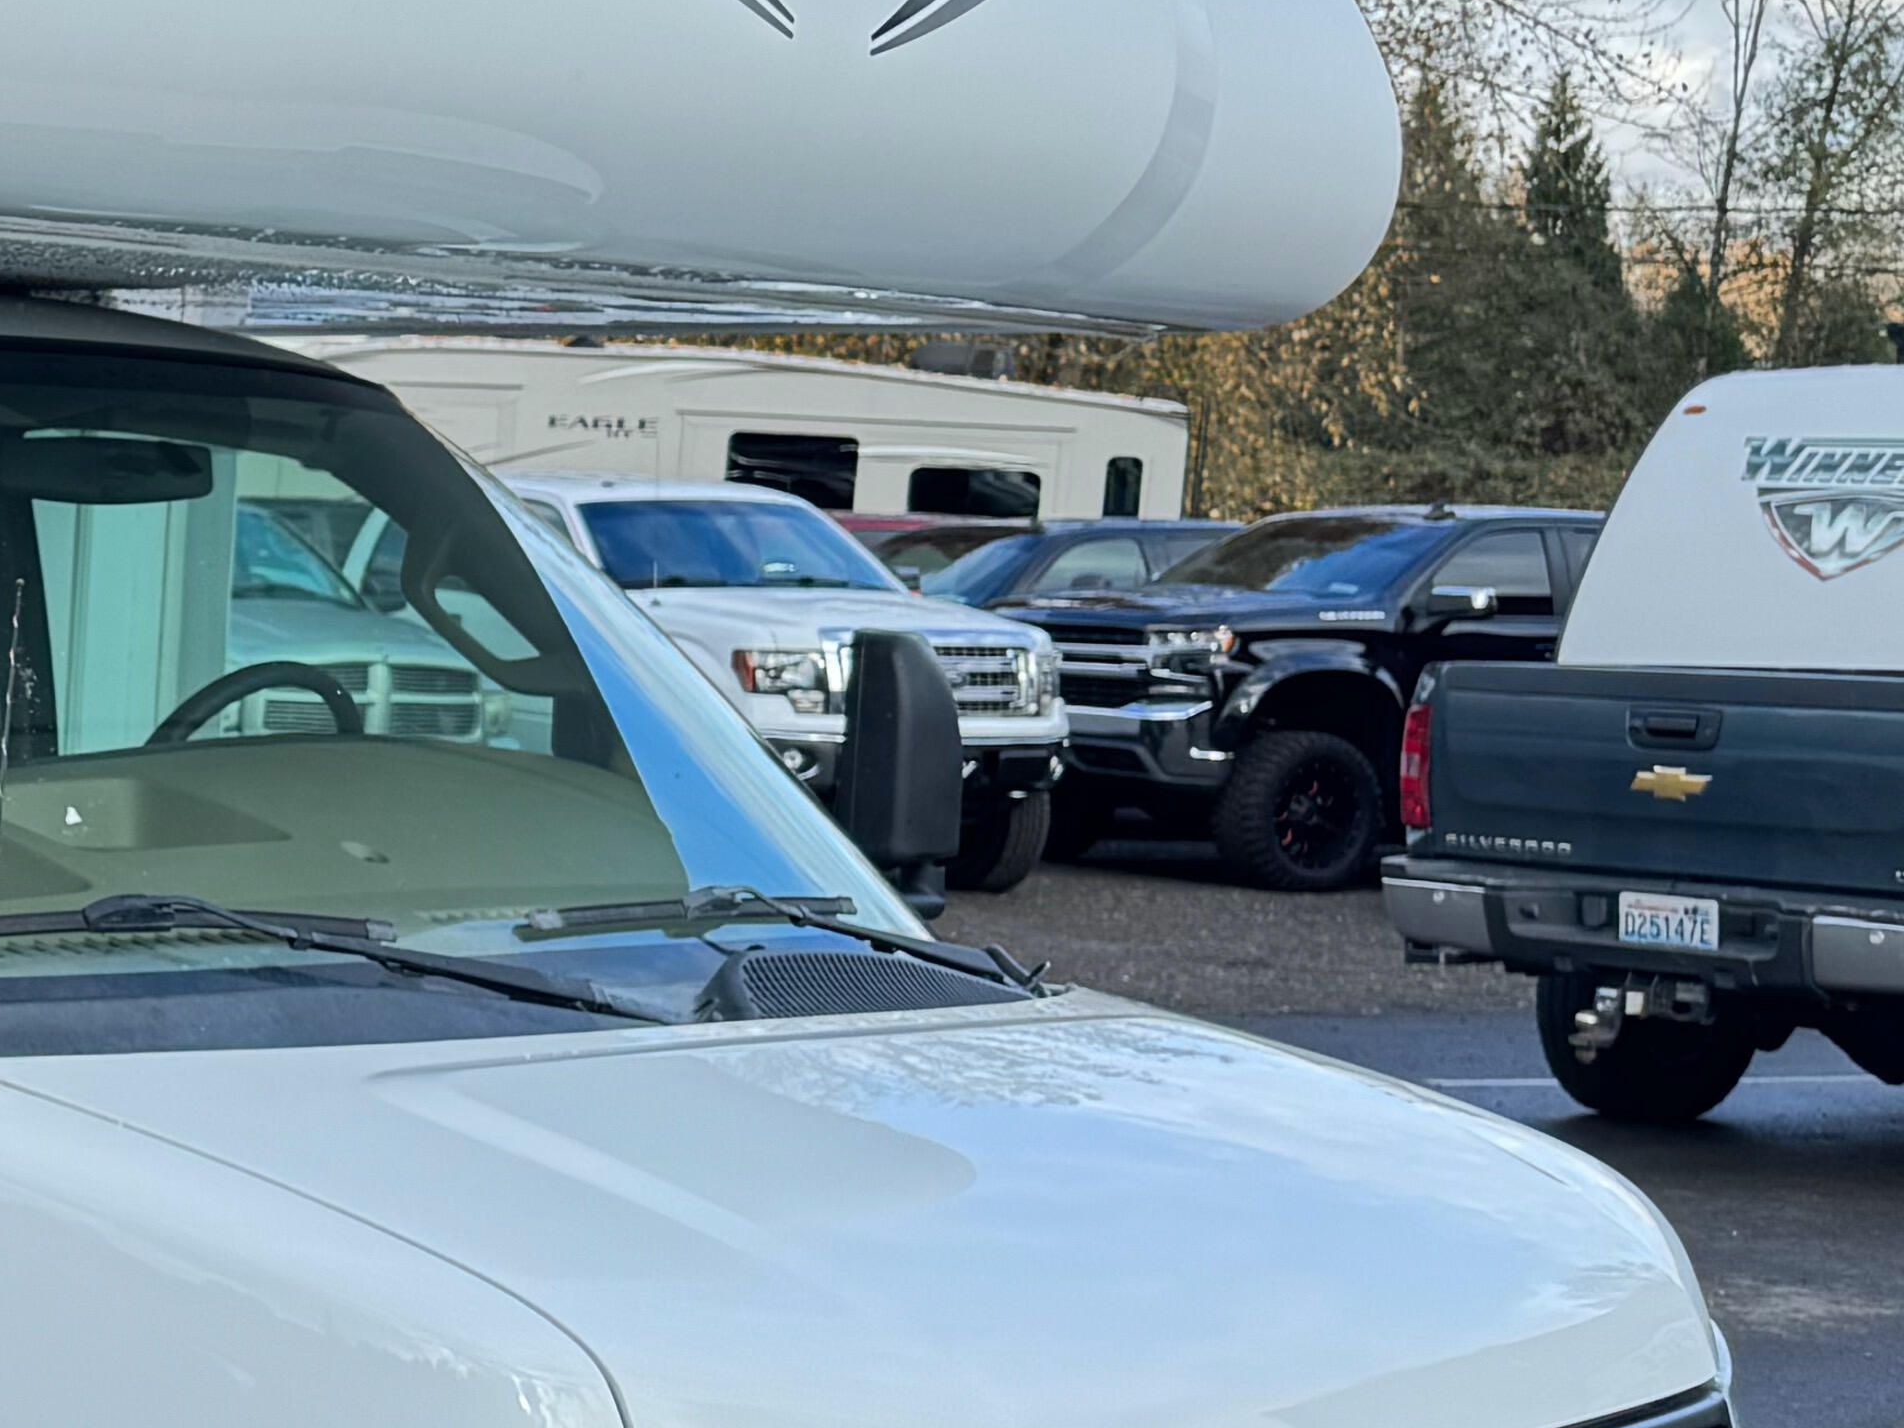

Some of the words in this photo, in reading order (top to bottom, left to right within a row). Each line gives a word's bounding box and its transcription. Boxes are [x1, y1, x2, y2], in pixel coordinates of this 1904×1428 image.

[548, 414, 659, 431] EAGLE
[1741, 436, 1904, 486] WINNE
[1624, 910, 1714, 946] D25147E
